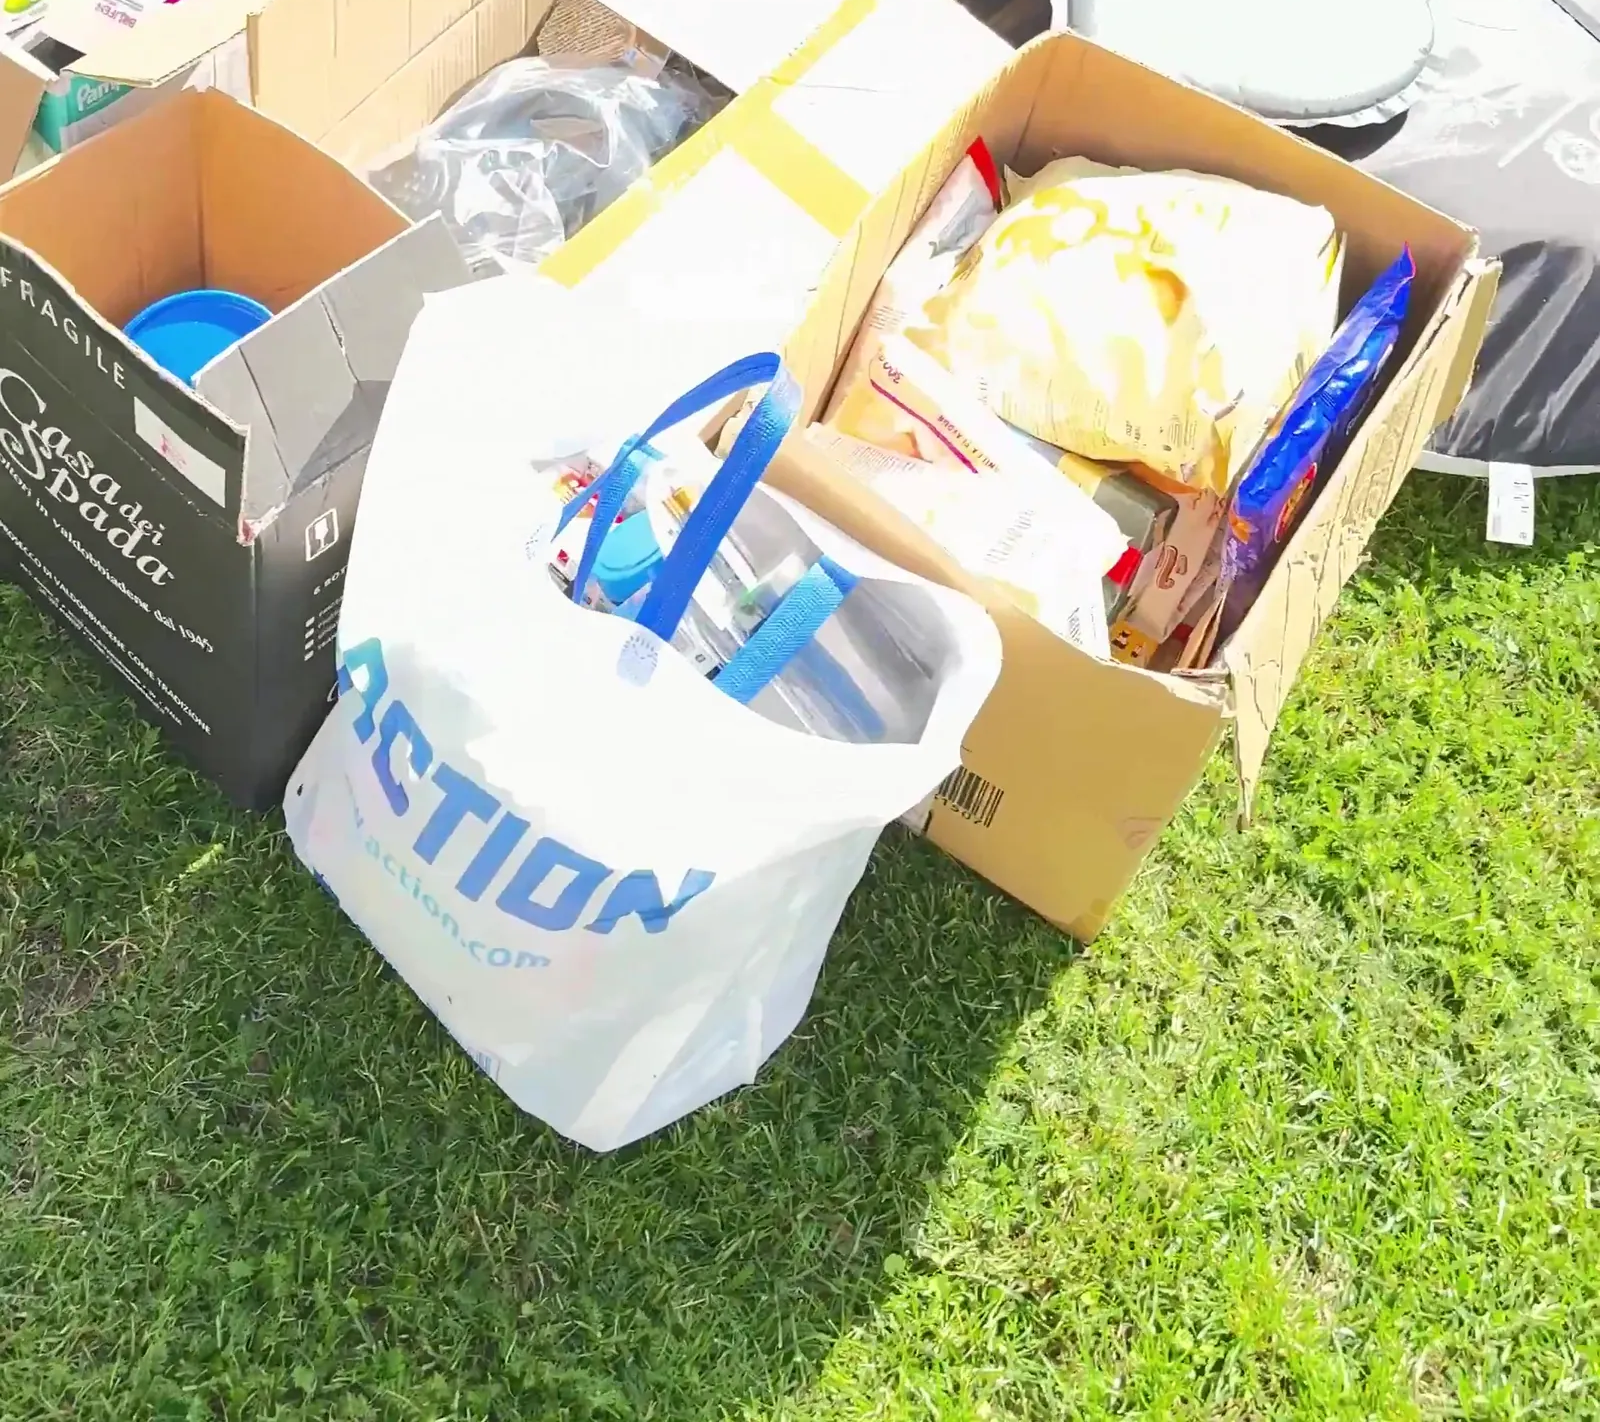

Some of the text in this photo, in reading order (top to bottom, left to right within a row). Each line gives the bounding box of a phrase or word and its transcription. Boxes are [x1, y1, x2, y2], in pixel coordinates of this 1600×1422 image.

[0, 266, 125, 389] FRAGILE
[0, 368, 121, 505] Casa
[119, 501, 166, 546] dei
[0, 423, 175, 586] Spada
[36, 497, 48, 516] in
[178, 624, 214, 653] 1945
[336, 636, 717, 936] ACTION
